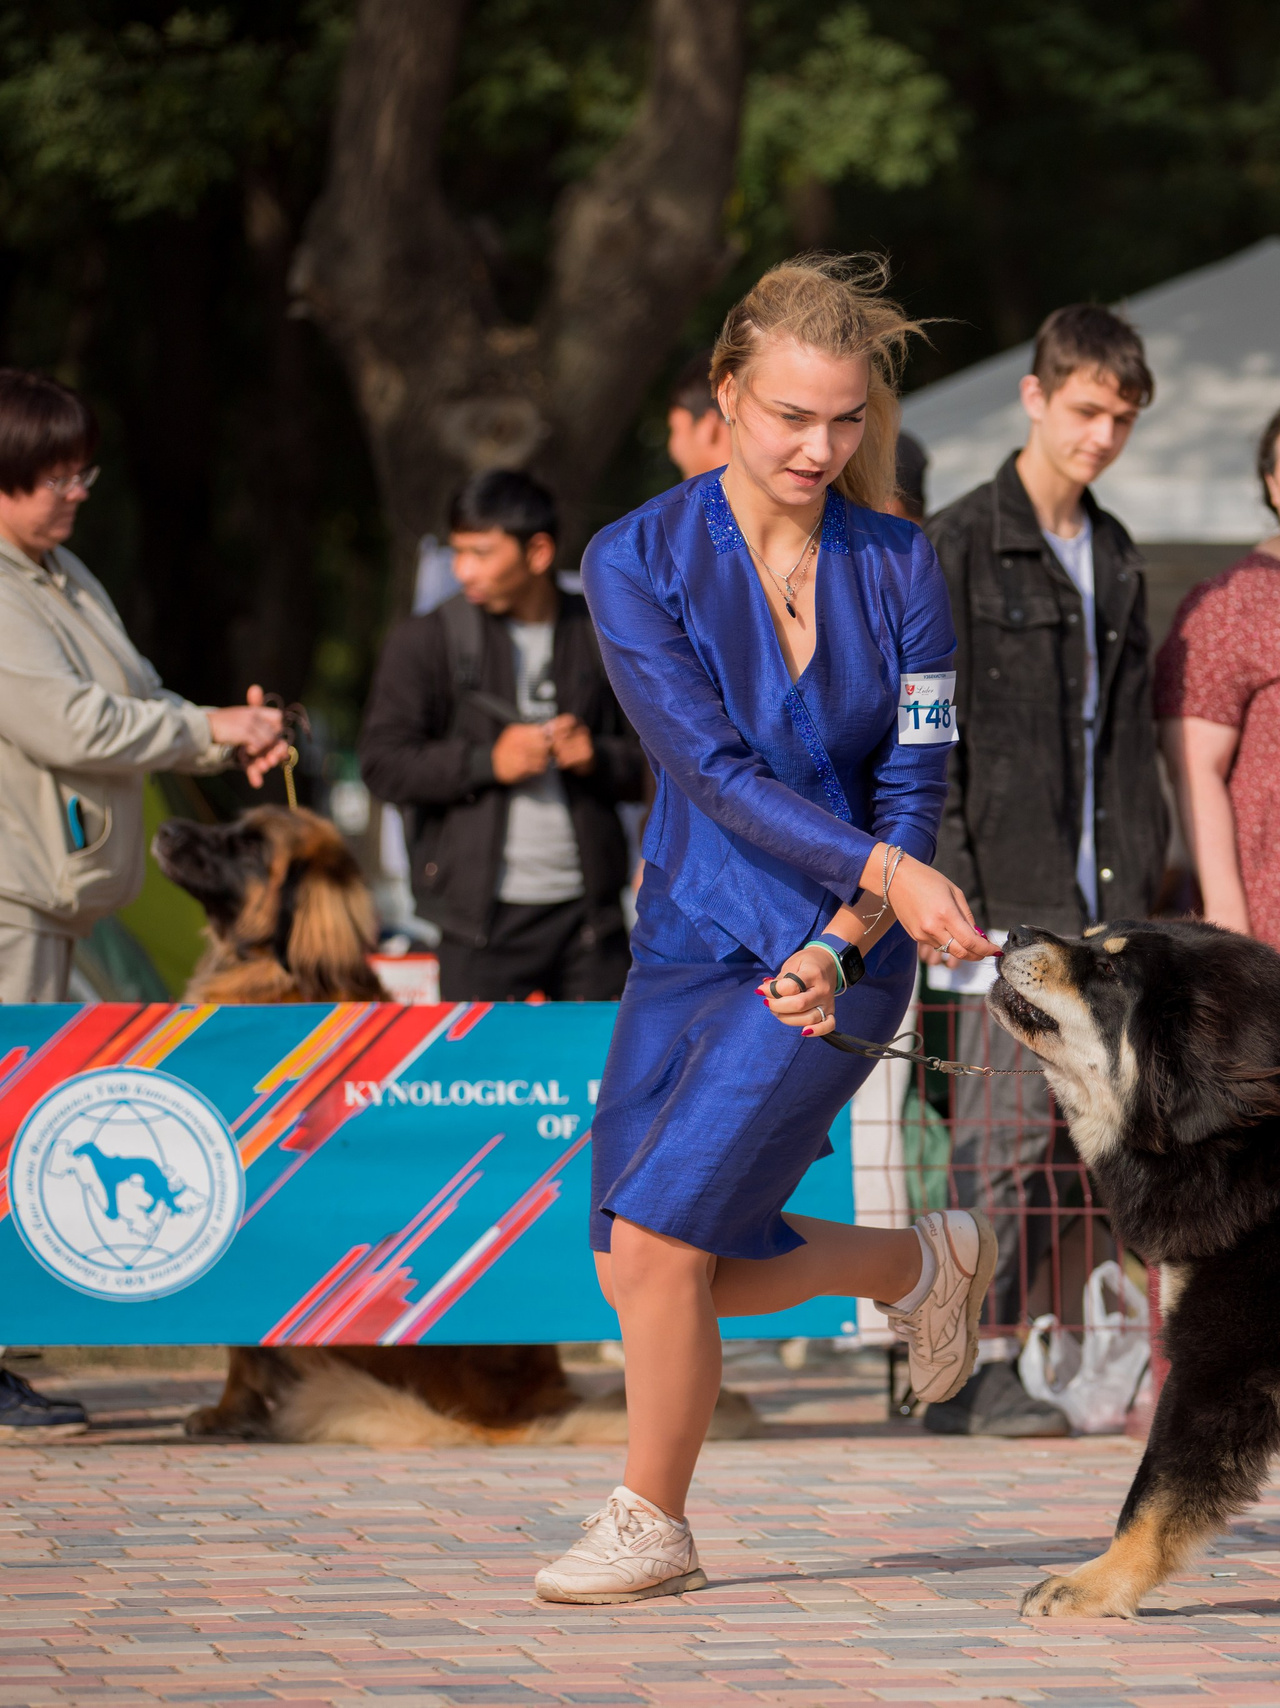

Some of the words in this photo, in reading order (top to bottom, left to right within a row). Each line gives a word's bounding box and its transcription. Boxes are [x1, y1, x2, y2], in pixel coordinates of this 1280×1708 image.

[906, 699, 951, 729] 148
[344, 1079, 569, 1107] KYNOLOGICAL
[537, 1113, 581, 1139] OF
